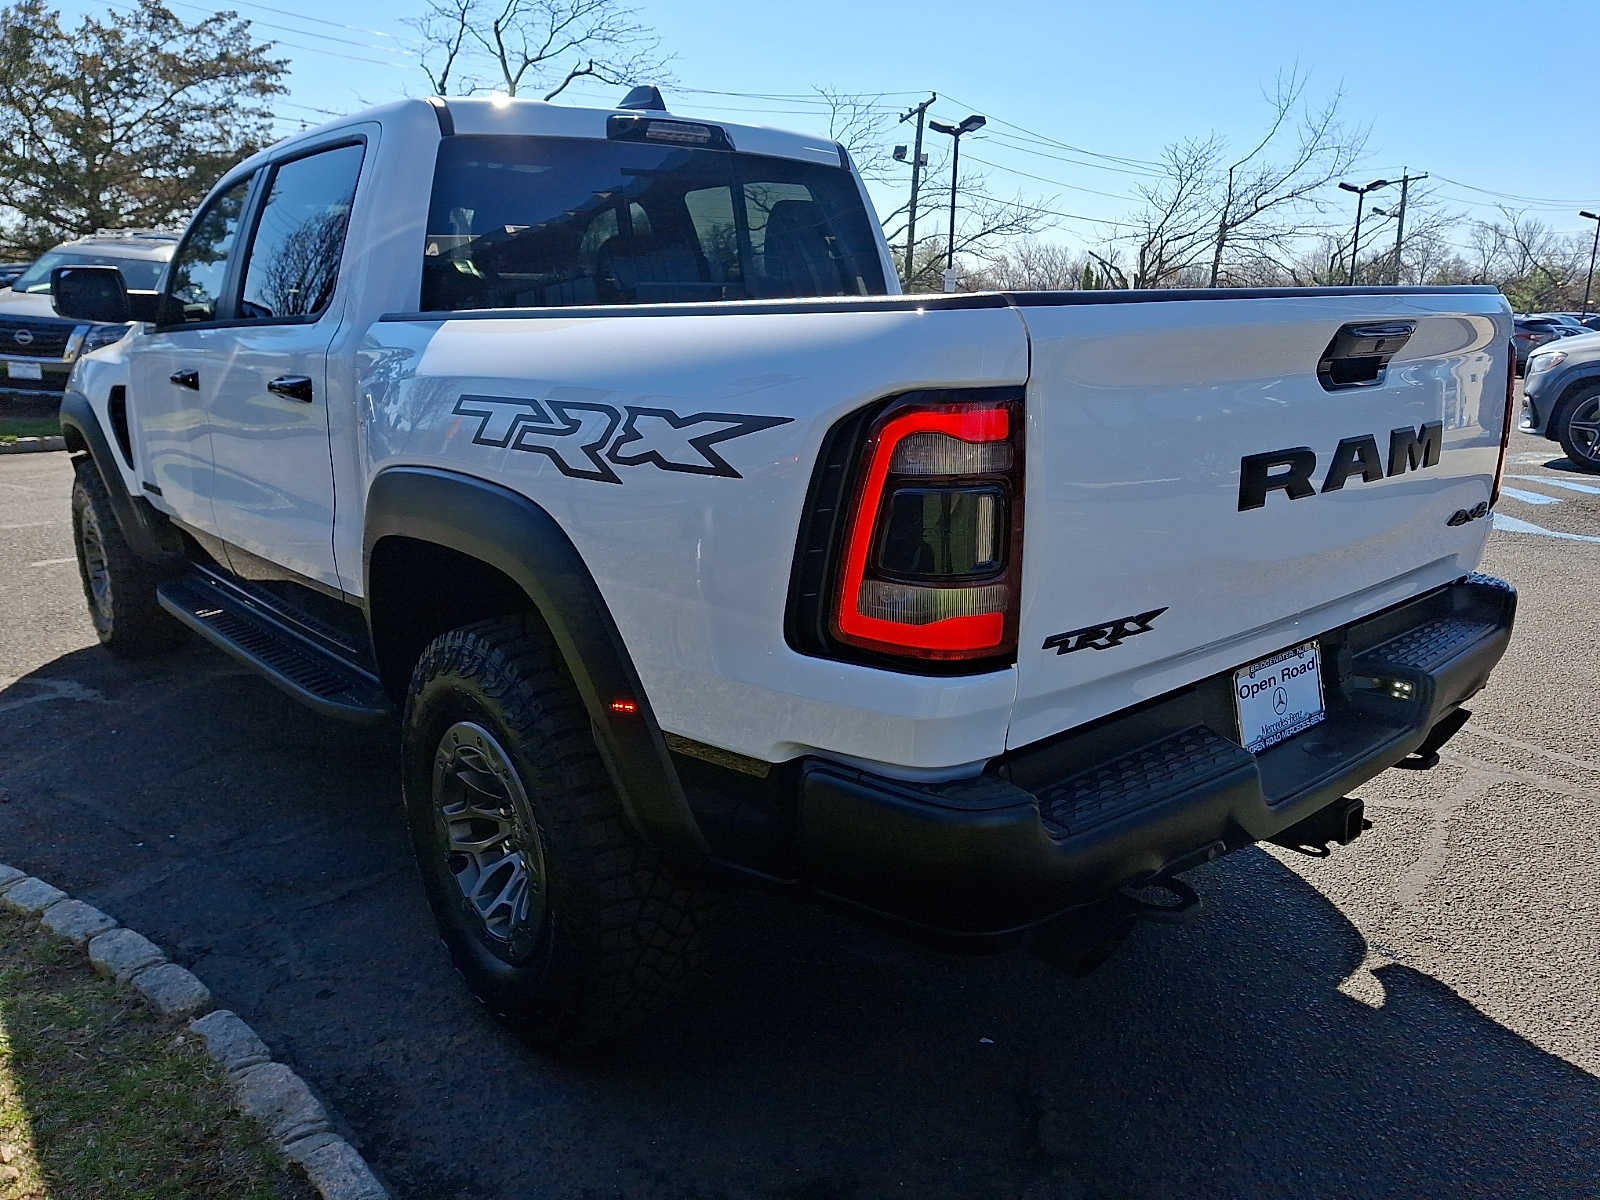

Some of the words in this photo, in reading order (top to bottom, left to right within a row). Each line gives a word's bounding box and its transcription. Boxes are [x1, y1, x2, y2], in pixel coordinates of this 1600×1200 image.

[452, 394, 796, 485] TRX
[1237, 420, 1443, 512] RAM
[1041, 606, 1170, 656] TRX
[1239, 676, 1277, 699] Open
[1281, 657, 1315, 682] Road
[1265, 732, 1282, 748] ROAD
